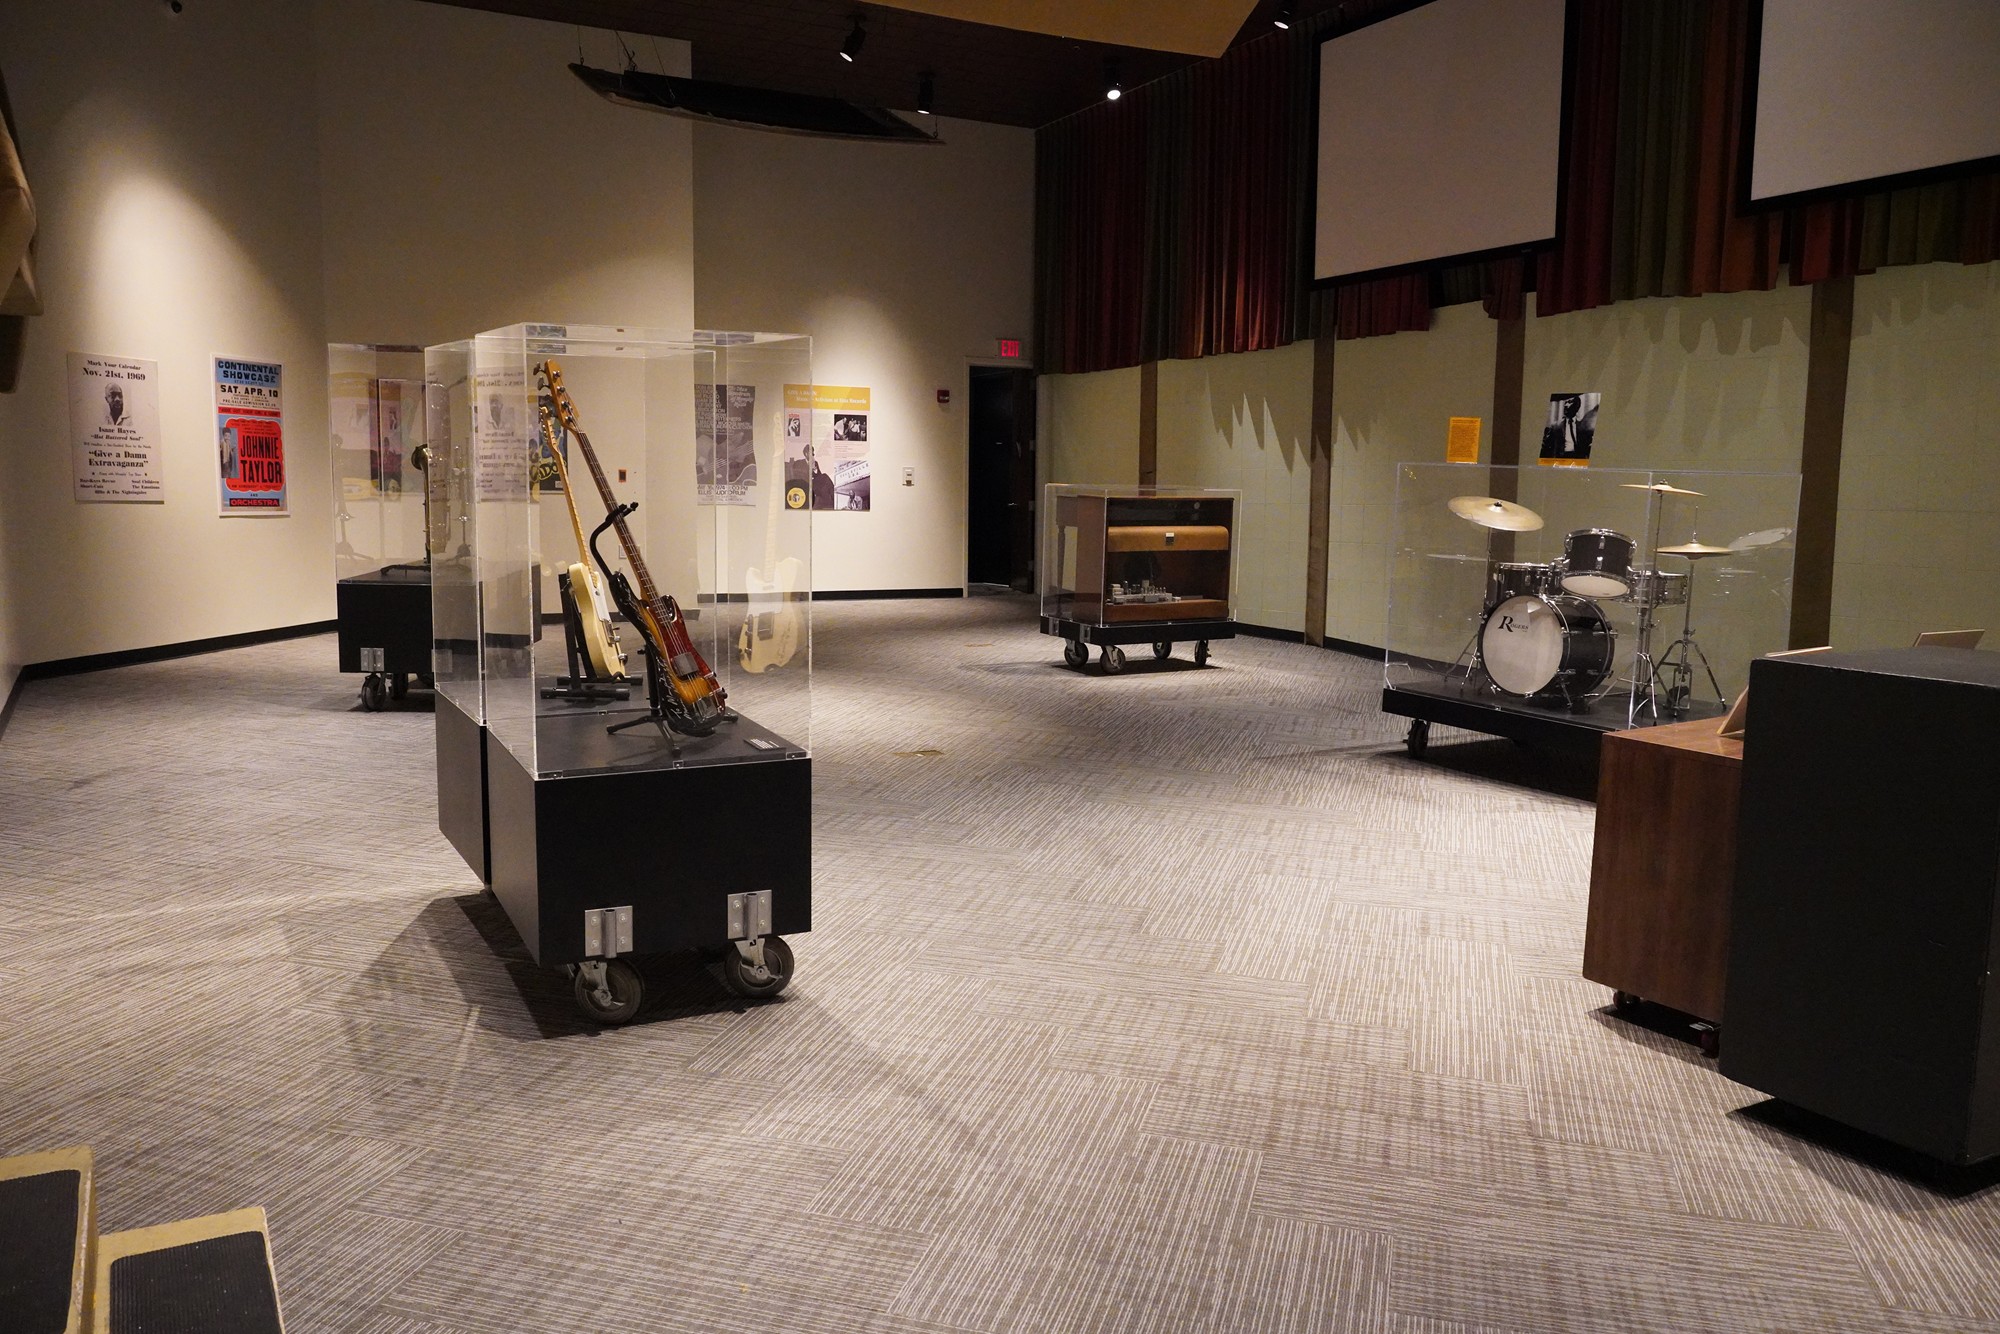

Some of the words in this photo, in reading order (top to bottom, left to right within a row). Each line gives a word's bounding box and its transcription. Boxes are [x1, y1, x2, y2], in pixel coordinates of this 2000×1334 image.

[1001, 340, 1018, 357] EXIT
[83, 367, 101, 376] Nov.
[105, 370, 124, 378] 21st.
[127, 372, 146, 380] 1969
[218, 361, 279, 375] CONTINENTAL
[223, 370, 276, 383] SHOWCASE
[220, 385, 241, 394] SAT.
[244, 387, 265, 396] APR.
[240, 435, 279, 459] JOHNNIE
[124, 451, 147, 459] Damn
[88, 458, 148, 468] Extravaganza"
[240, 460, 282, 483] TAYLOR
